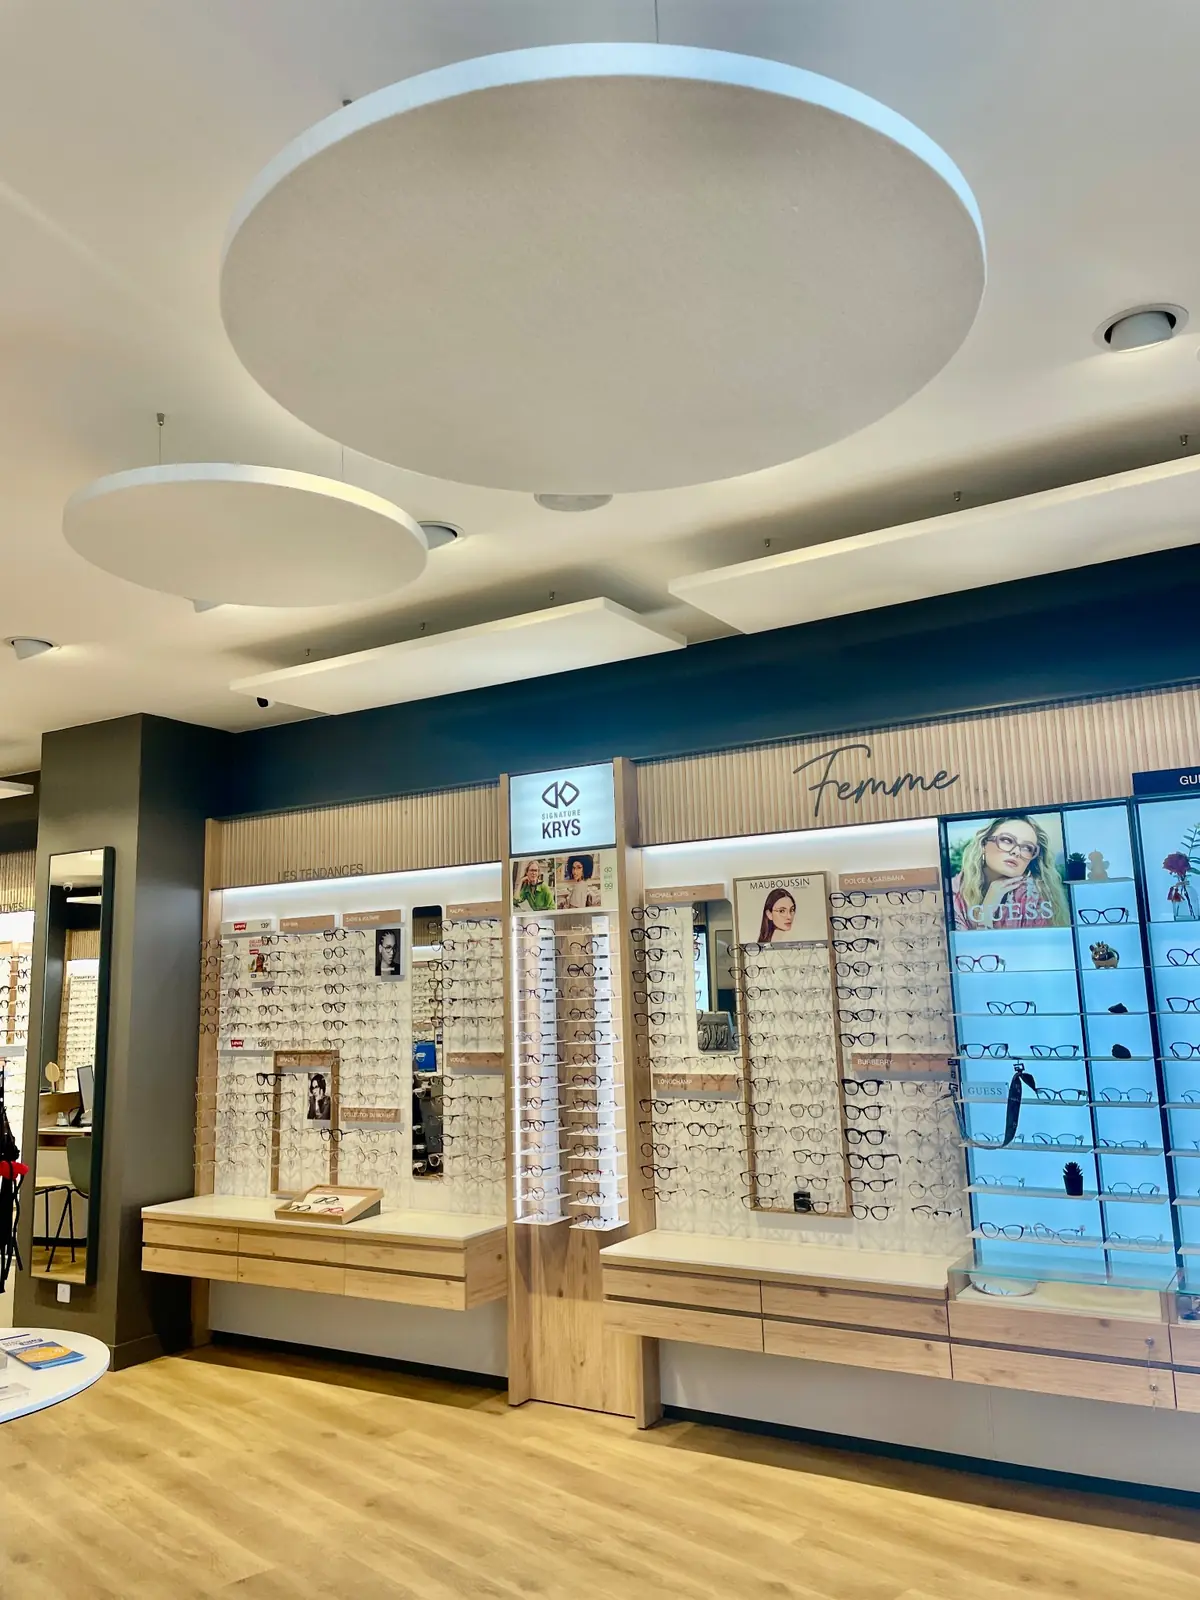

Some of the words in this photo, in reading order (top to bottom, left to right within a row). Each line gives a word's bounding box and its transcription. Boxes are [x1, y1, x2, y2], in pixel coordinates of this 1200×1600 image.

[793, 744, 960, 817] Femme
[1179, 774, 1200, 786] GU
[541, 809, 581, 821] SIGNATURE
[541, 818, 581, 840] KRYS
[300, 863, 364, 881] TENDANCES
[749, 877, 810, 890] MAUBOUSSIN
[967, 901, 1055, 922] GUESS
[967, 1087, 1003, 1096] GUESS
